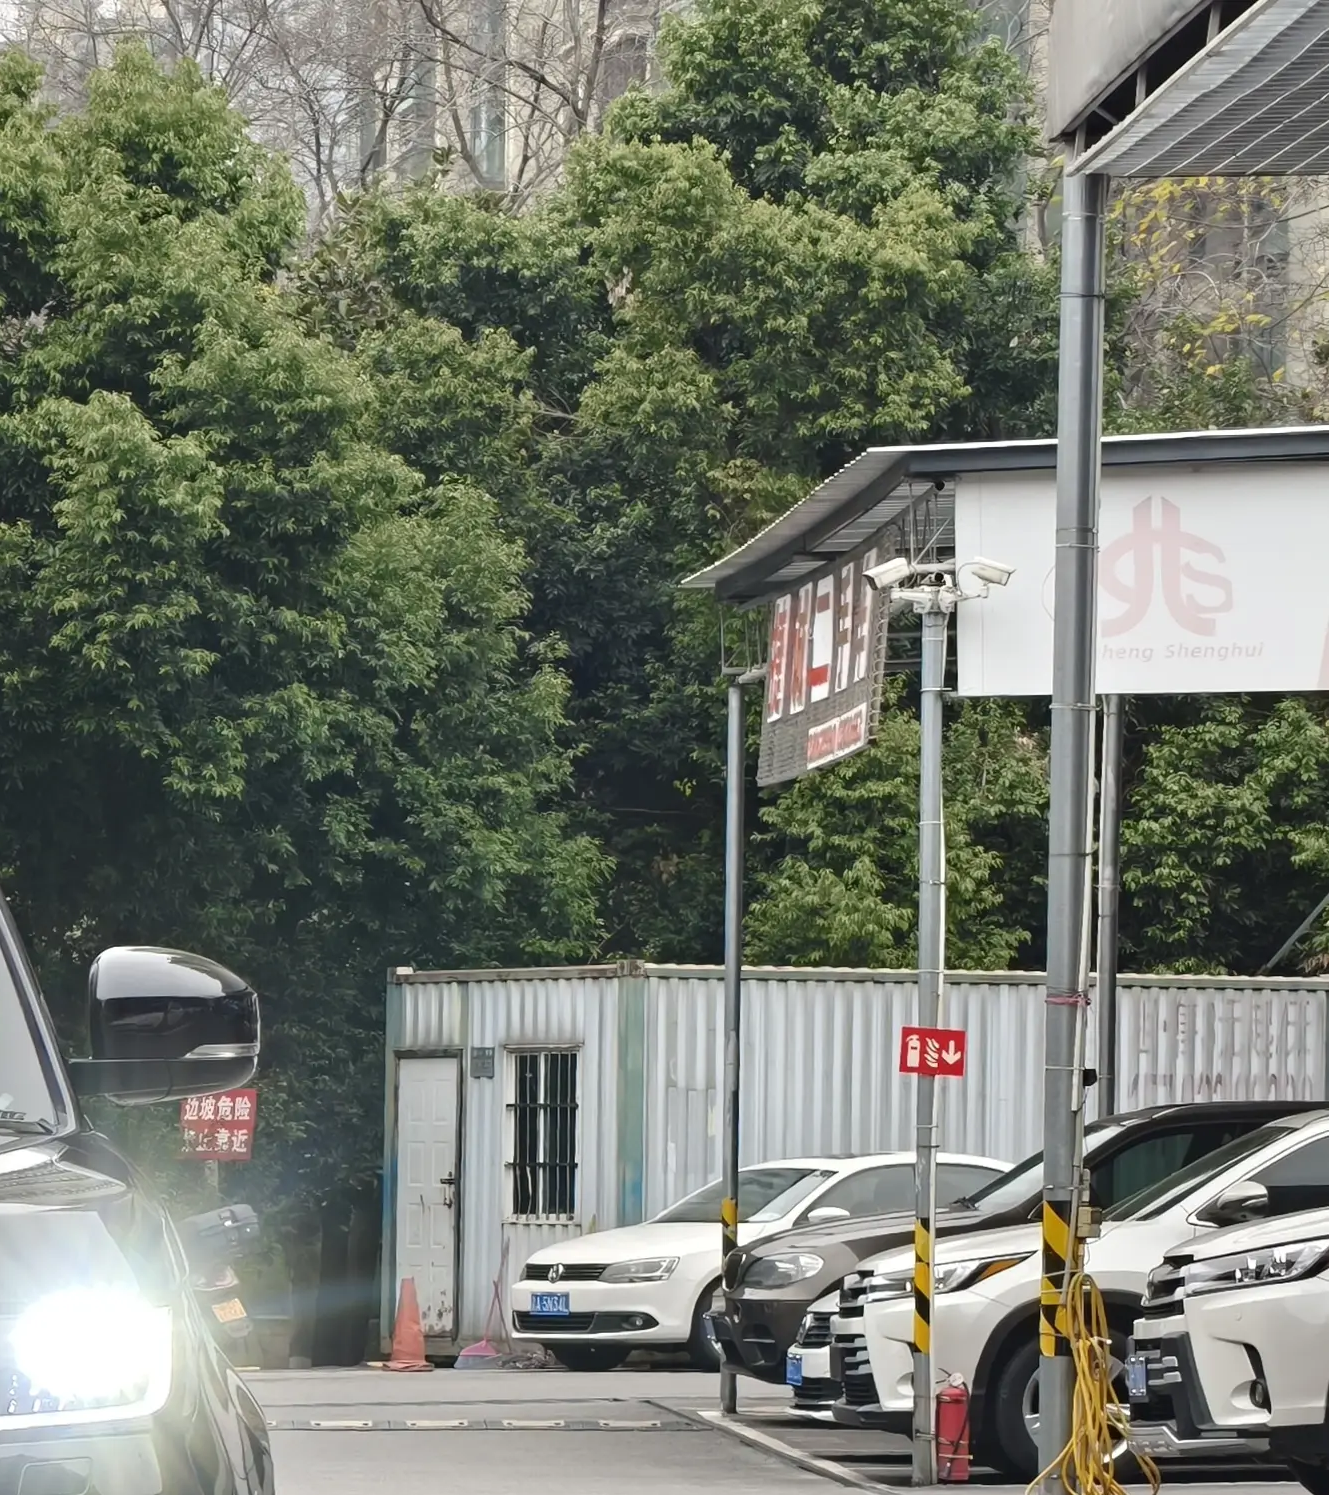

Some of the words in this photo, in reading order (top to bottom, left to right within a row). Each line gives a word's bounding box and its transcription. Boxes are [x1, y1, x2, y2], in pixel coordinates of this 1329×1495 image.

[1165, 642, 1264, 662] Shenghui
[183, 1096, 252, 1121] 边坡危险
